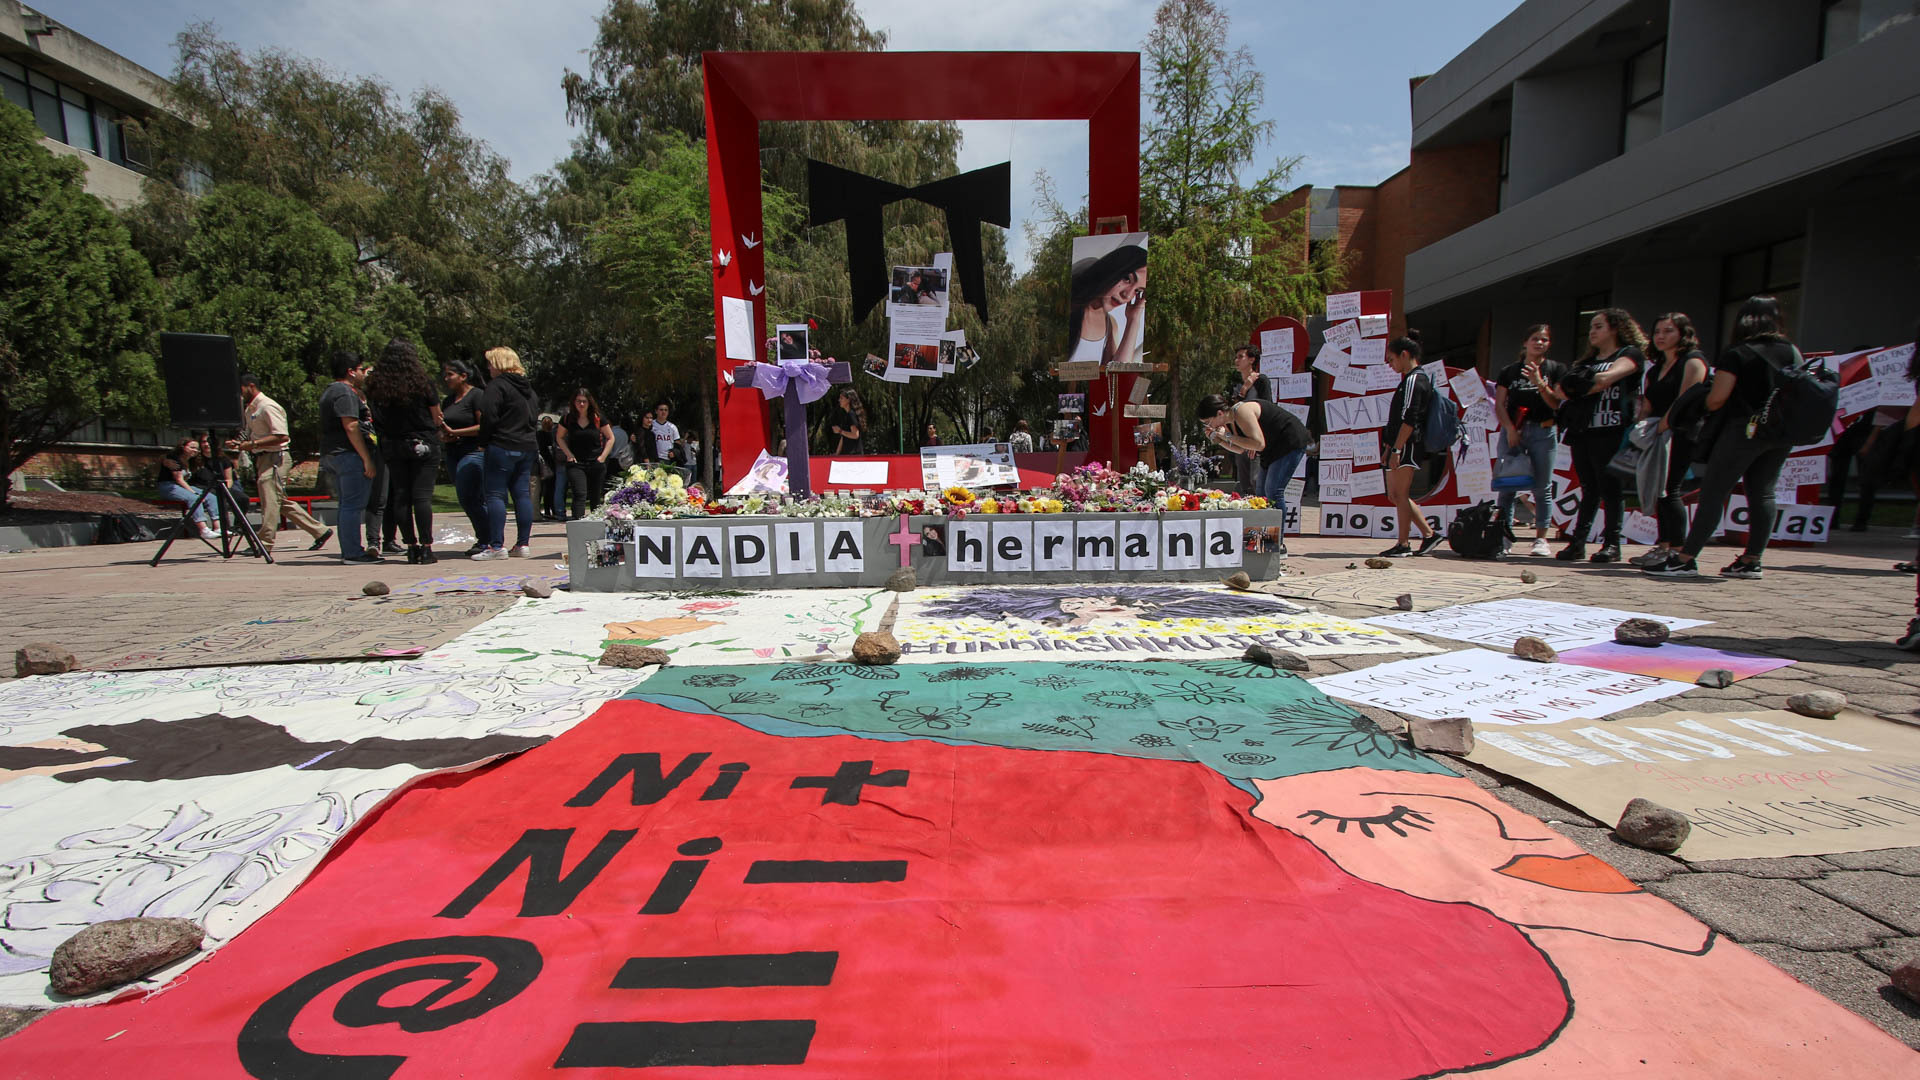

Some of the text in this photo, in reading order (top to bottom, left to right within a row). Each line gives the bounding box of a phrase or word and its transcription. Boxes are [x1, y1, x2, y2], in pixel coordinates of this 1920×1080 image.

[639, 530, 1235, 565] NADIA hermana
[1489, 708, 1548, 723] NO
[1475, 718, 1873, 767] NADIA
[563, 751, 751, 807] Ni
[432, 827, 723, 919] Ni
[236, 934, 543, 1080] @
